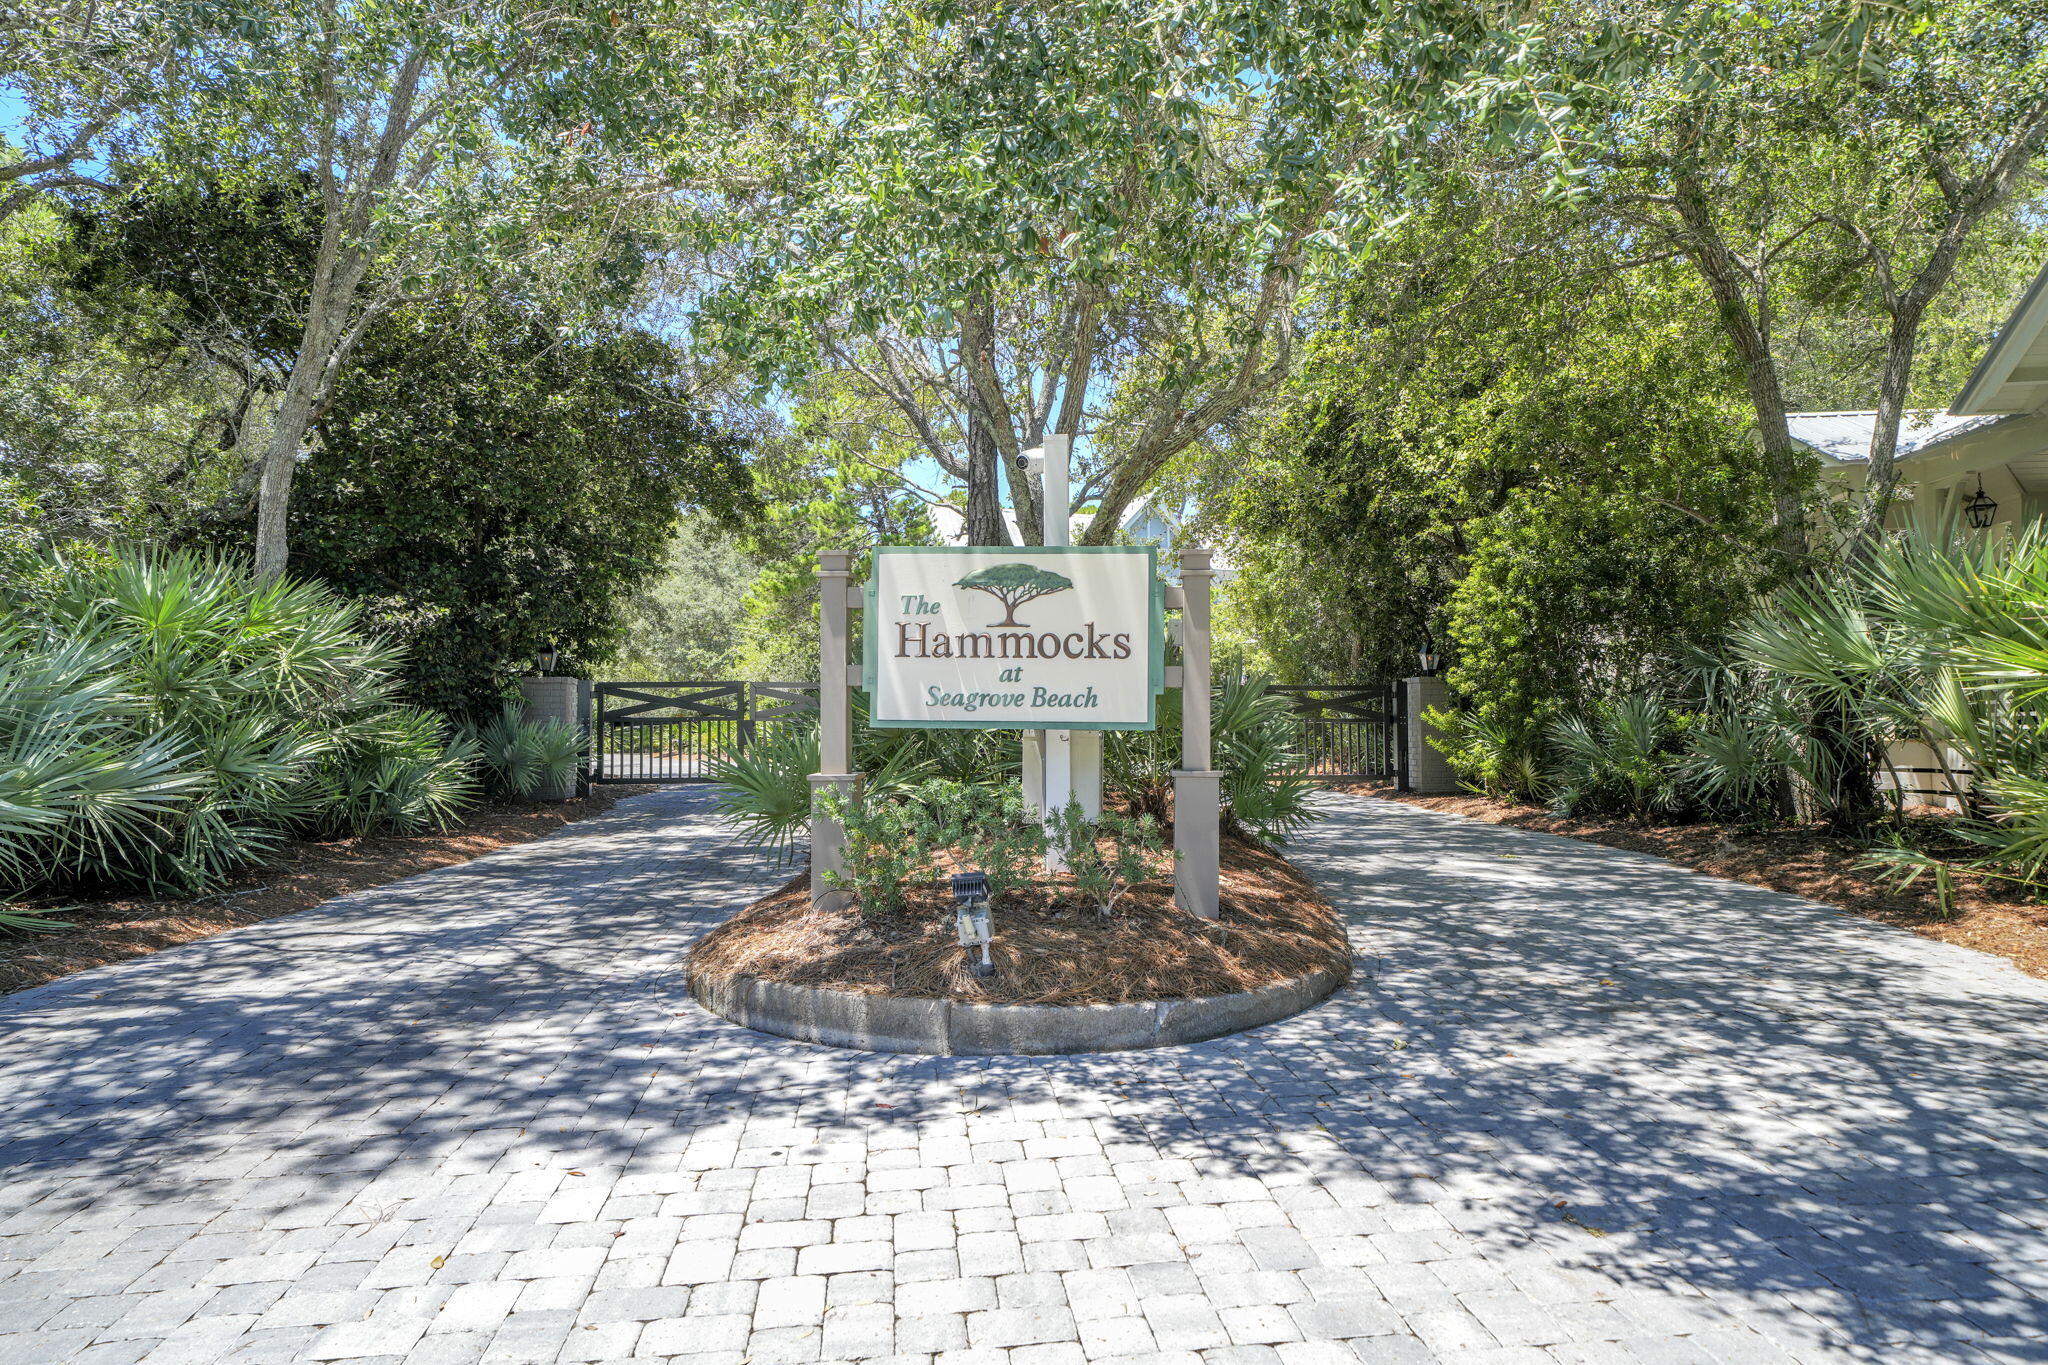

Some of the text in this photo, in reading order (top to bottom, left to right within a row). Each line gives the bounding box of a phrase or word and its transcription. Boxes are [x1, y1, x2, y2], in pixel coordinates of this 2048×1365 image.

[900, 594, 941, 615] The
[894, 621, 1132, 660] Hammocks
[999, 666, 1023, 683] at
[926, 685, 1098, 712] Seagrove Beach
